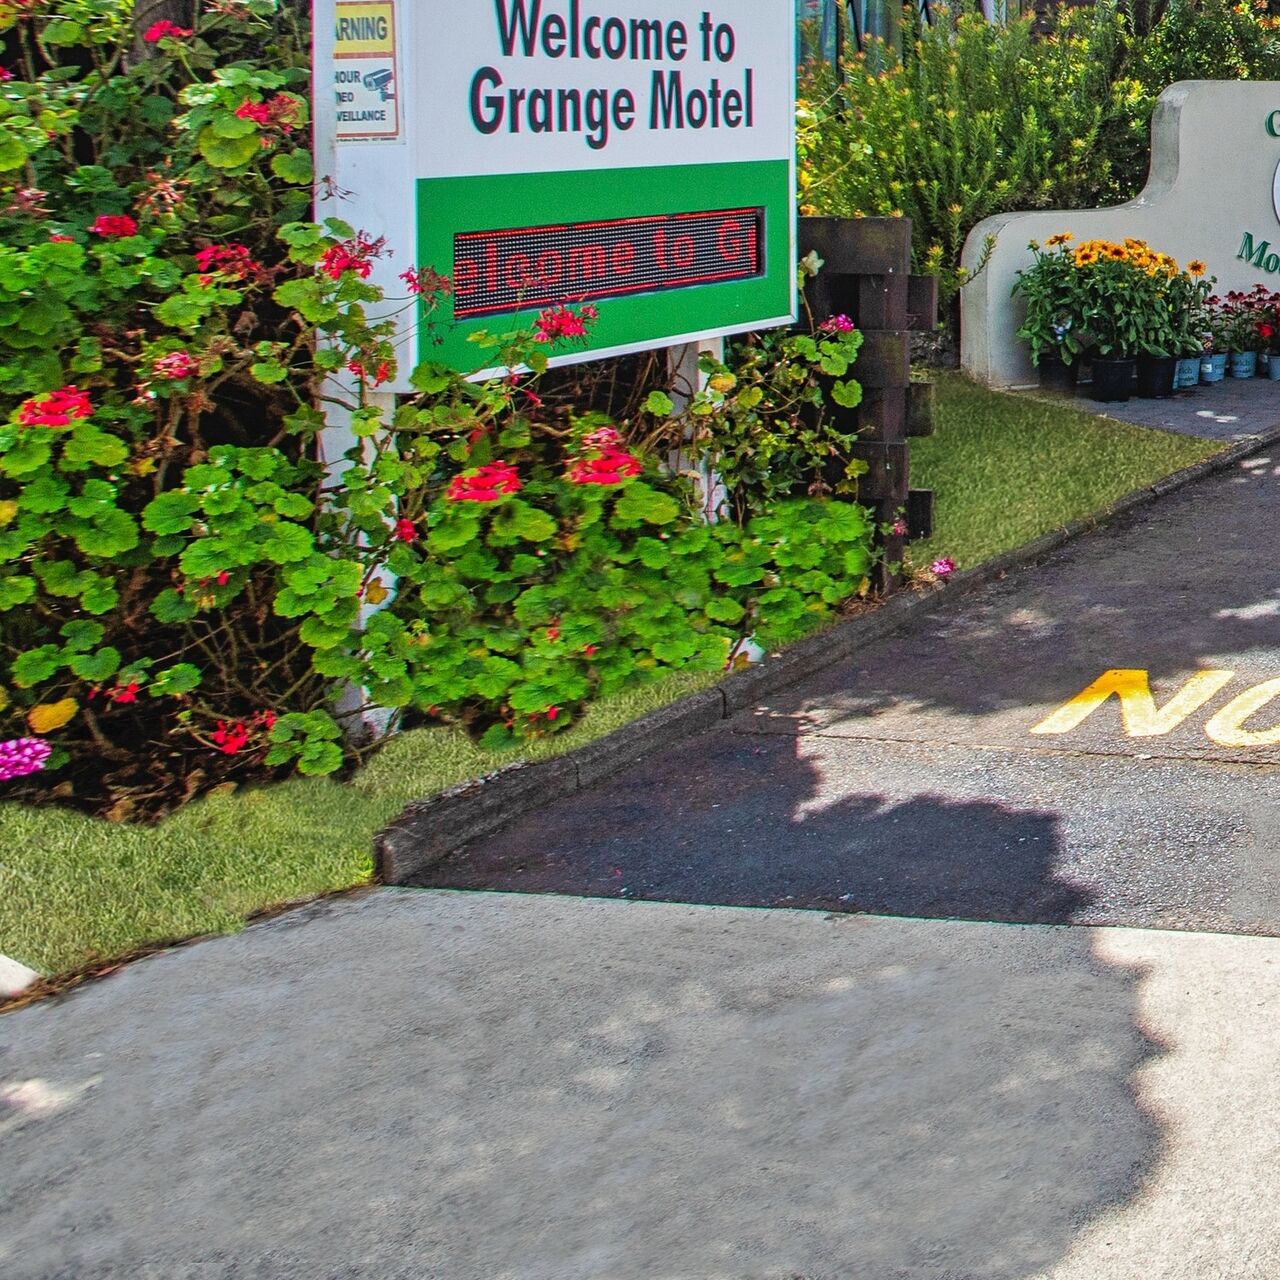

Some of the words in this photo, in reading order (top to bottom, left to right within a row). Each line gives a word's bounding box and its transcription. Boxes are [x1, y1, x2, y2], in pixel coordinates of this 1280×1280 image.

[699, 11, 735, 62] to
[469, 66, 635, 150] Grange
[649, 68, 753, 131] Motel
[652, 228, 695, 269] to
